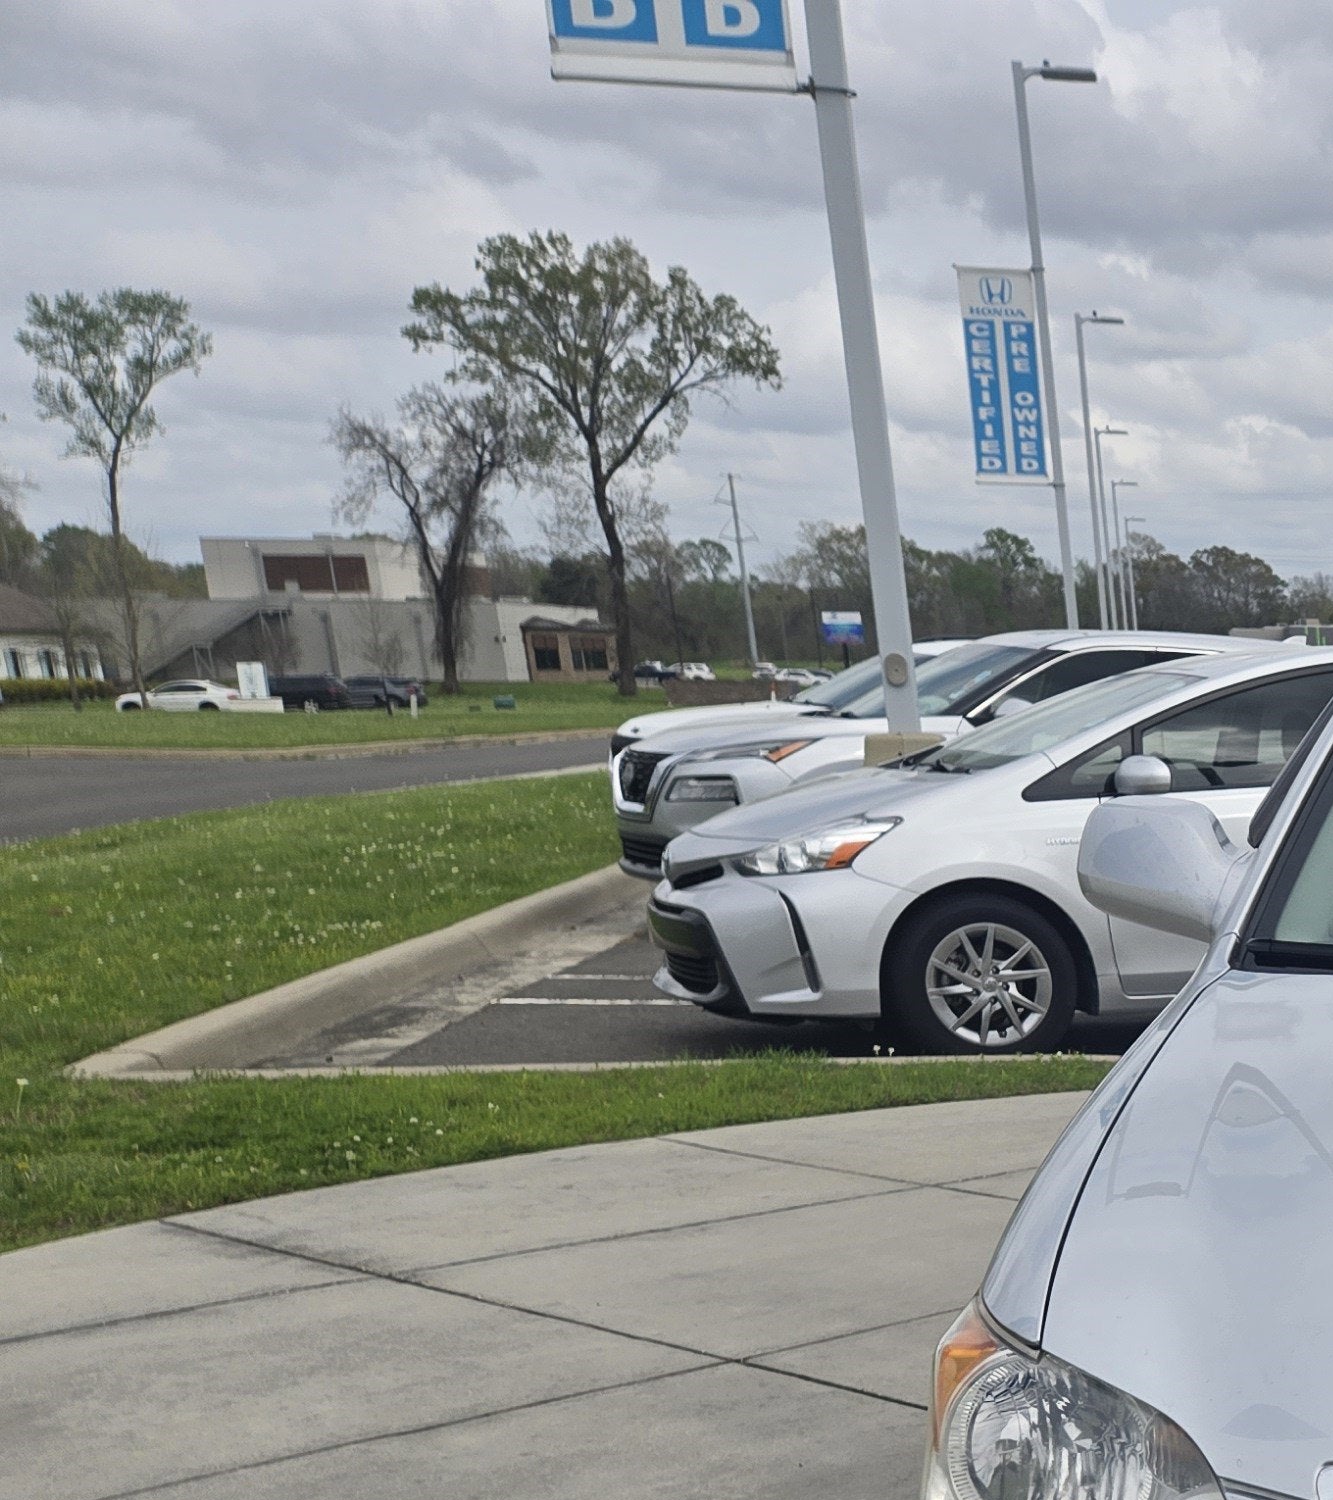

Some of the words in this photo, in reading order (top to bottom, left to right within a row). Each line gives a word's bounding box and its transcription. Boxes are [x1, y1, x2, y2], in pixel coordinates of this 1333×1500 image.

[968, 305, 1027, 318] HONDA
[1010, 323, 1032, 374] PRE
[968, 321, 1003, 471] CERTIFIED
[1013, 390, 1040, 472] OWNED
